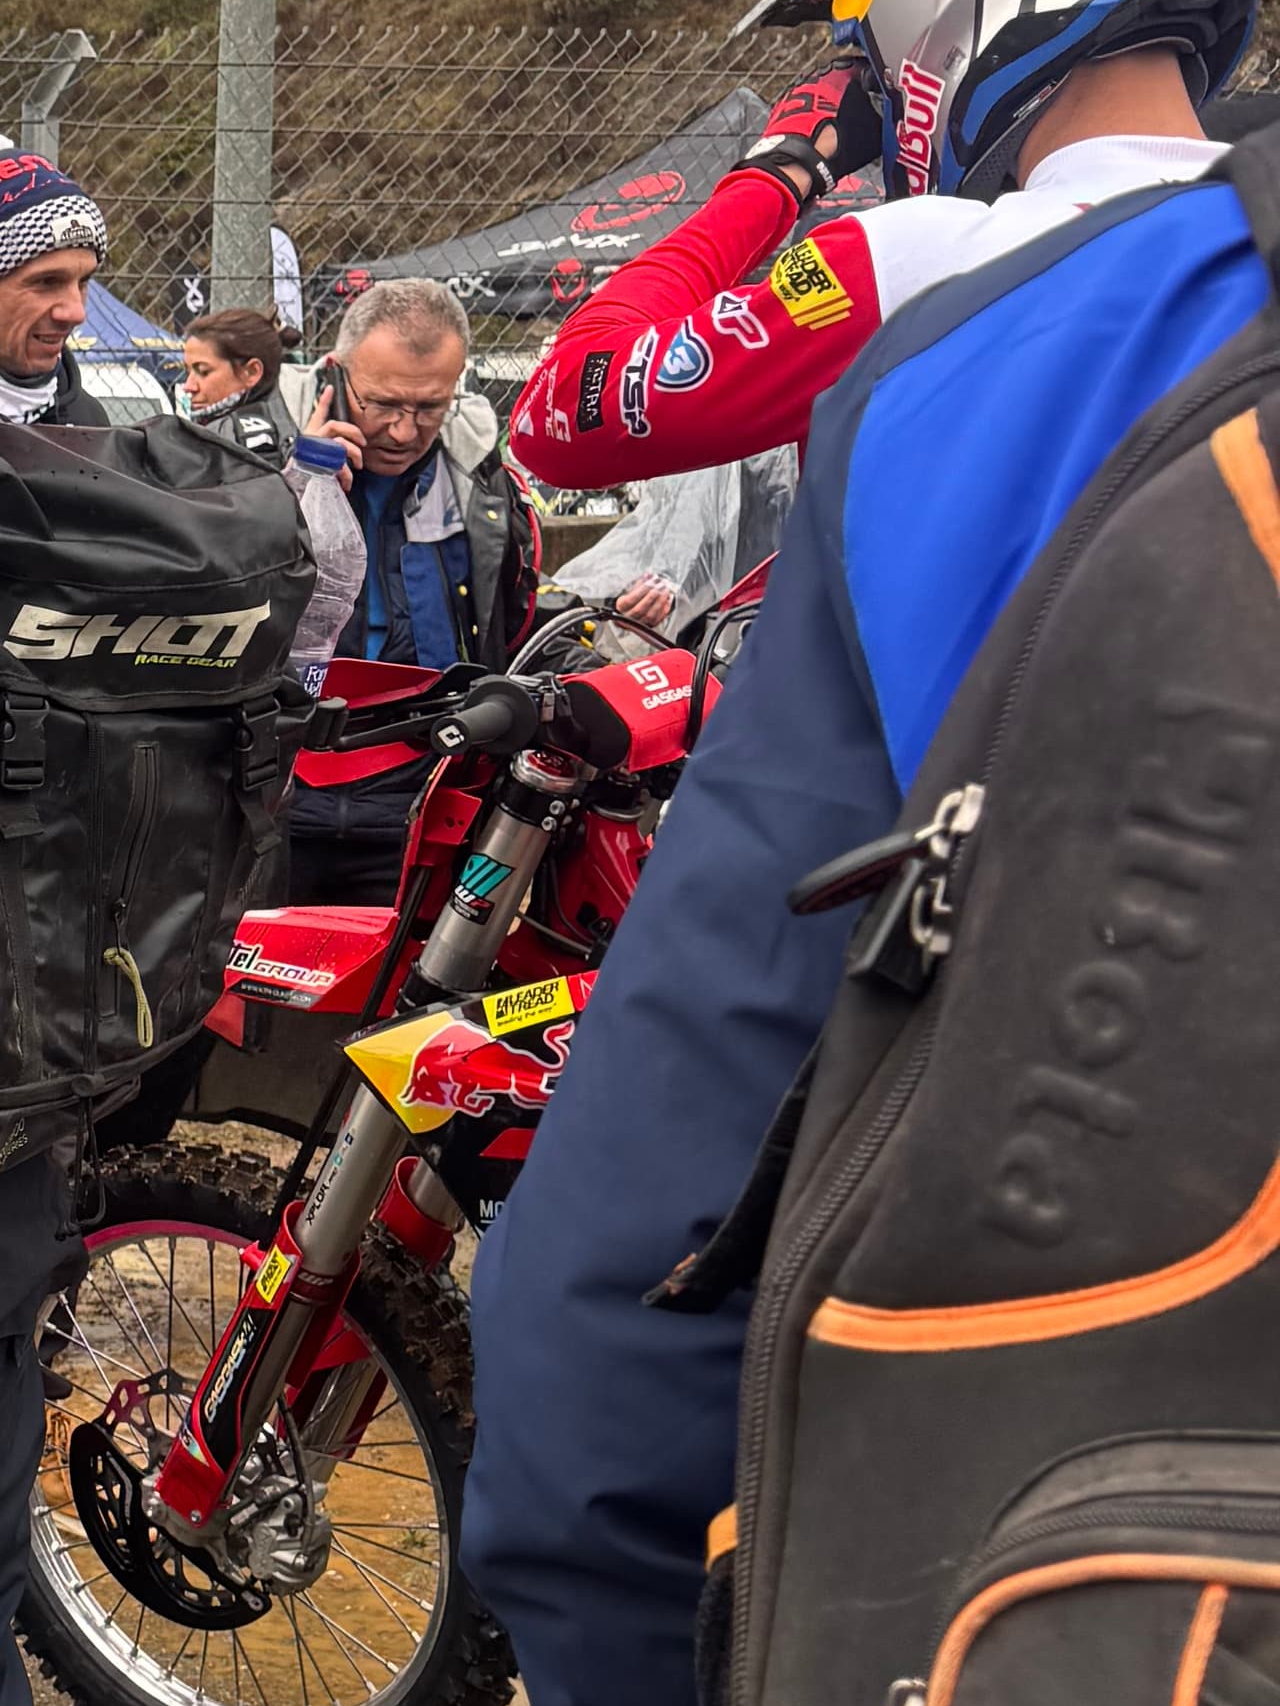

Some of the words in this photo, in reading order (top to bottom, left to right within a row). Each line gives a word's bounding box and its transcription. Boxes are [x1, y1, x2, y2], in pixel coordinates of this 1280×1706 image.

[2, 600, 271, 660] SHOT
[135, 654, 182, 667] RACE
[187, 655, 238, 669] GEAR
[641, 686, 694, 711] GASGAS
